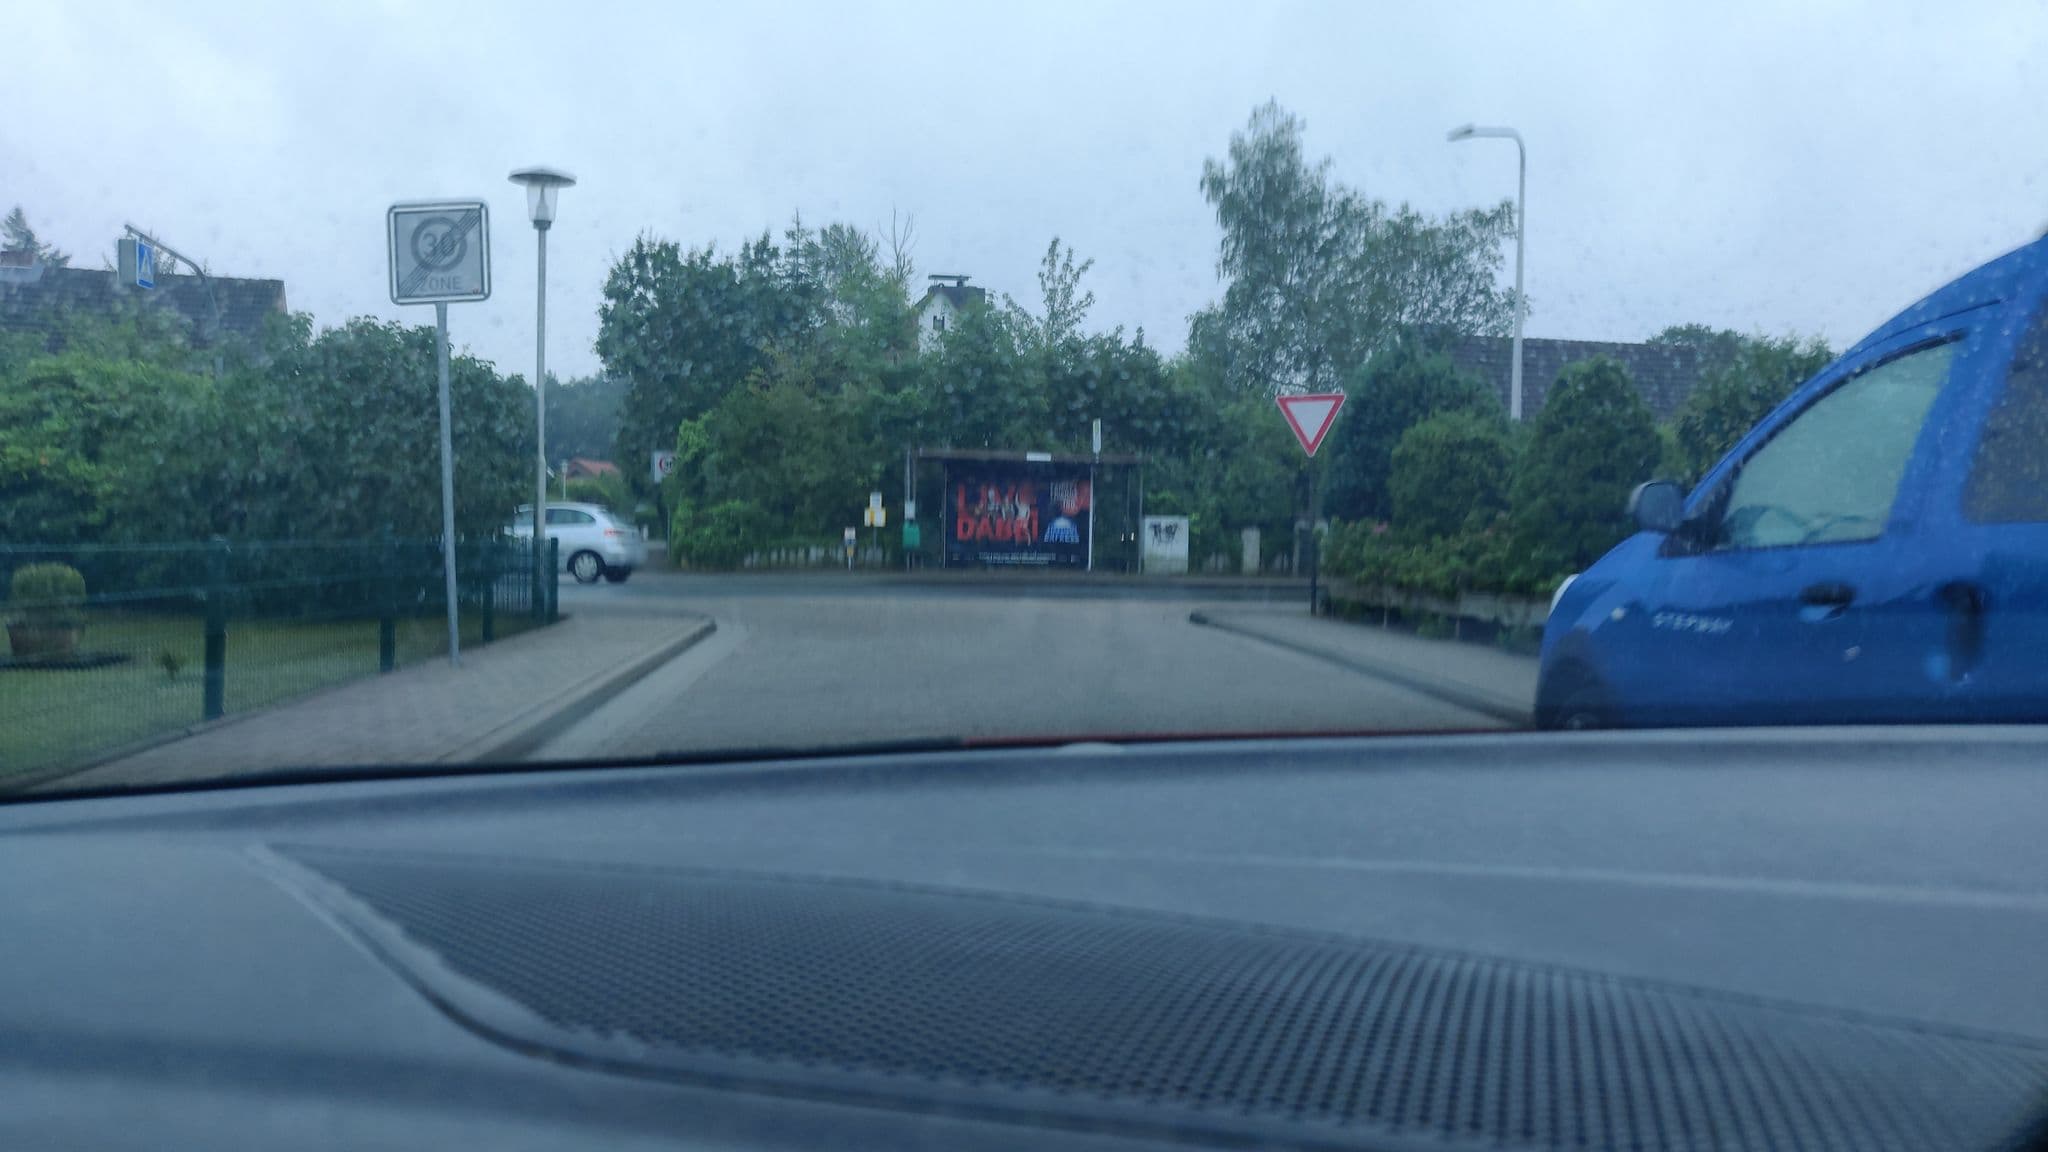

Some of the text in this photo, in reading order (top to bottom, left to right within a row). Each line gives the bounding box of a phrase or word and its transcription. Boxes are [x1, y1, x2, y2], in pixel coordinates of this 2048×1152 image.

[422, 232, 456, 258] 30
[419, 275, 463, 291] ZONE
[1653, 612, 1735, 634] STEPWAY
